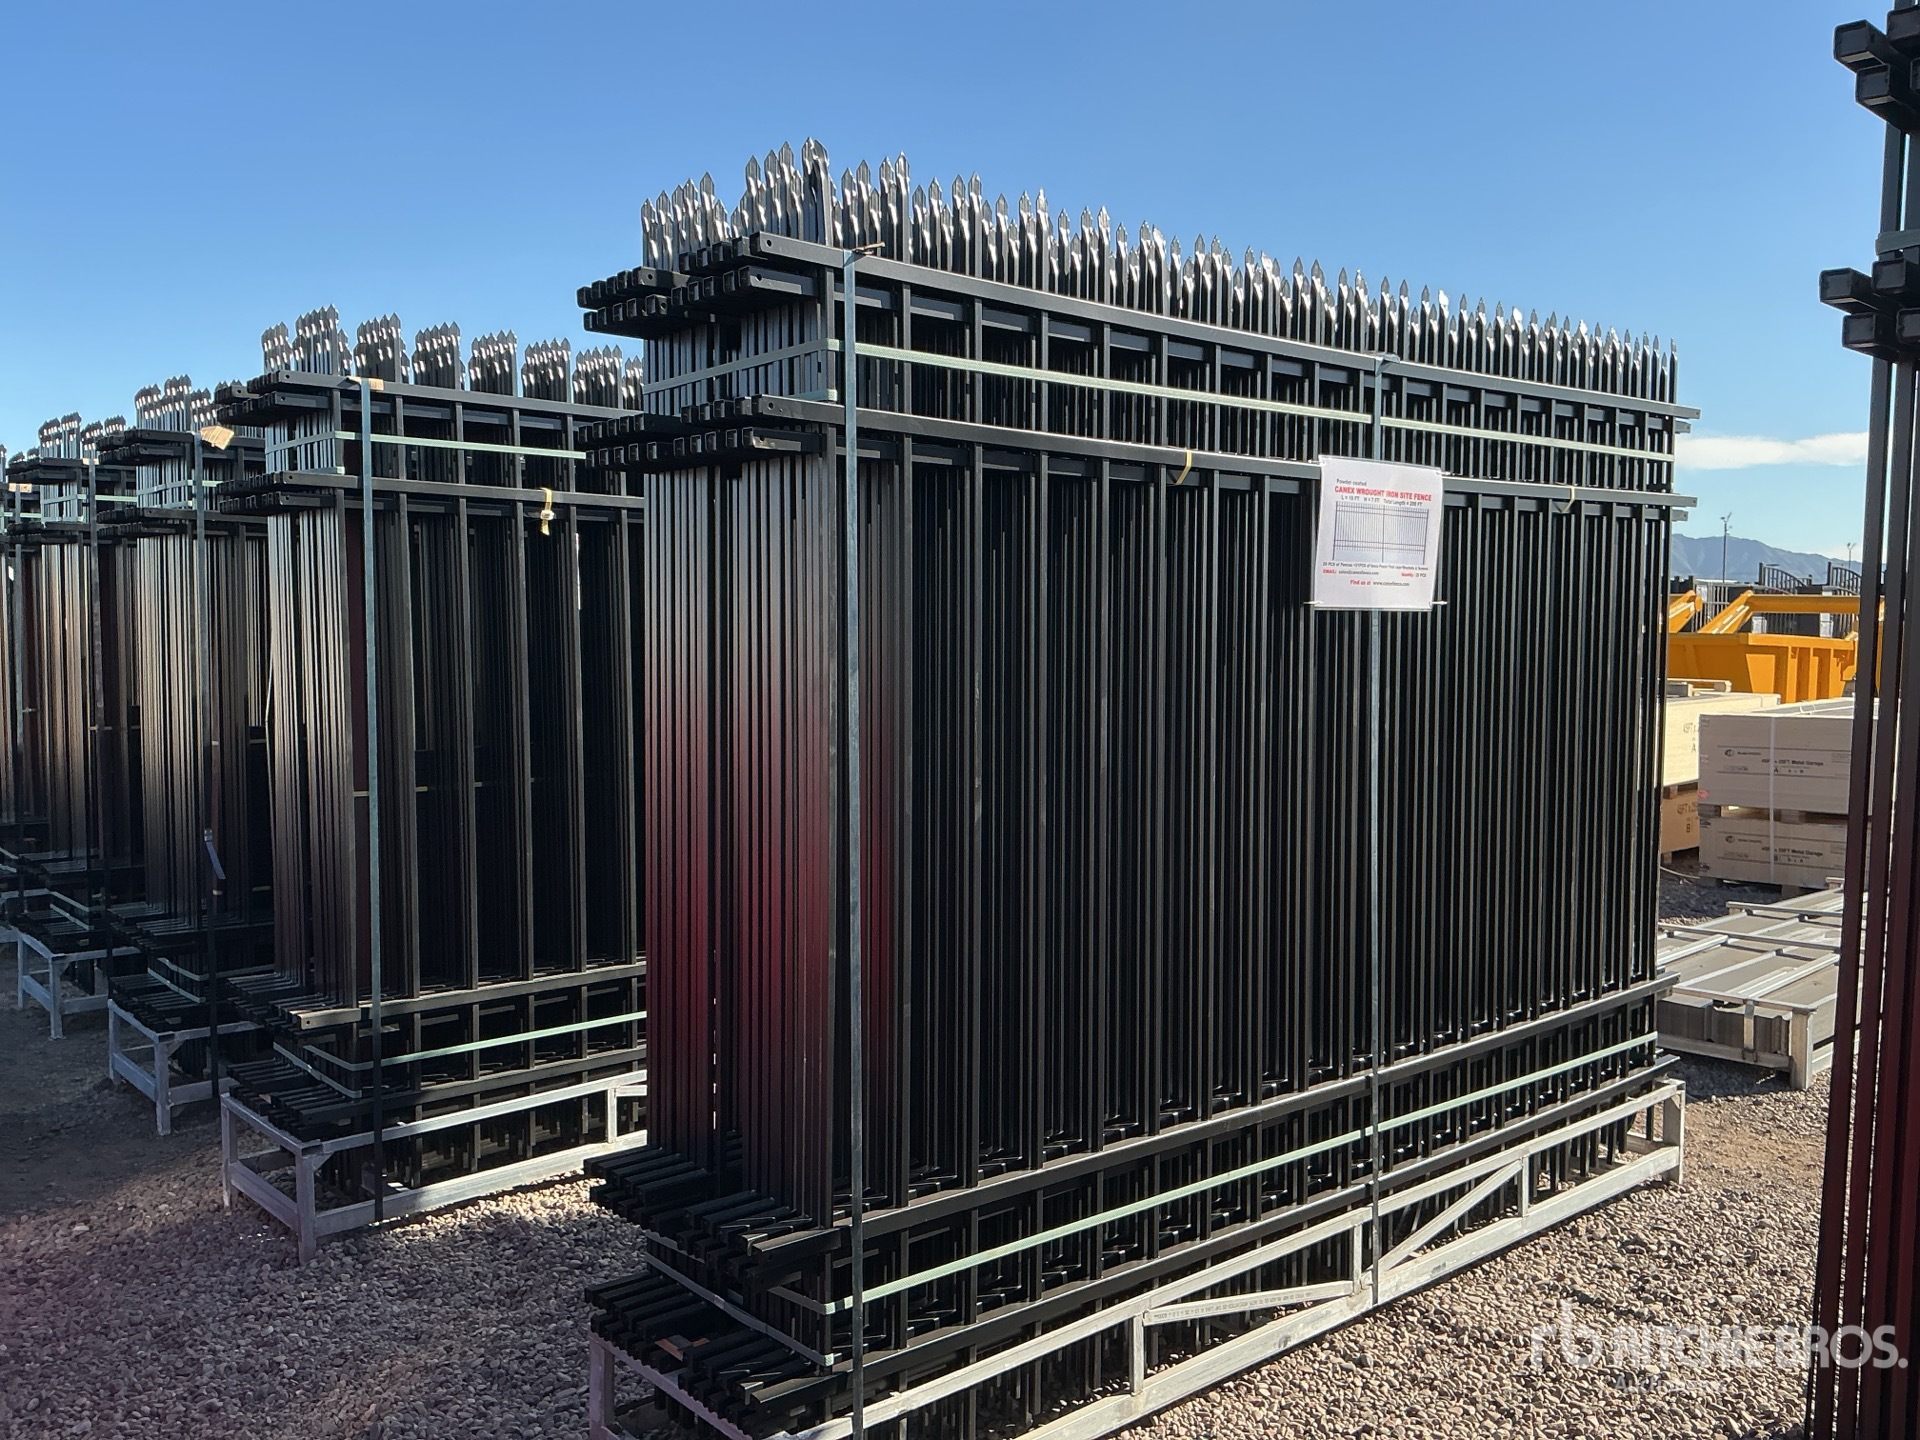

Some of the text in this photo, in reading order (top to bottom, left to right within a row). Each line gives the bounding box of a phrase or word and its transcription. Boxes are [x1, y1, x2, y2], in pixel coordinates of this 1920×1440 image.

[1335, 486, 1355, 494] CANEX
[1356, 488, 1385, 497] WROUGHT
[1386, 490, 1399, 498] IRON
[1414, 493, 1432, 501] FENCE
